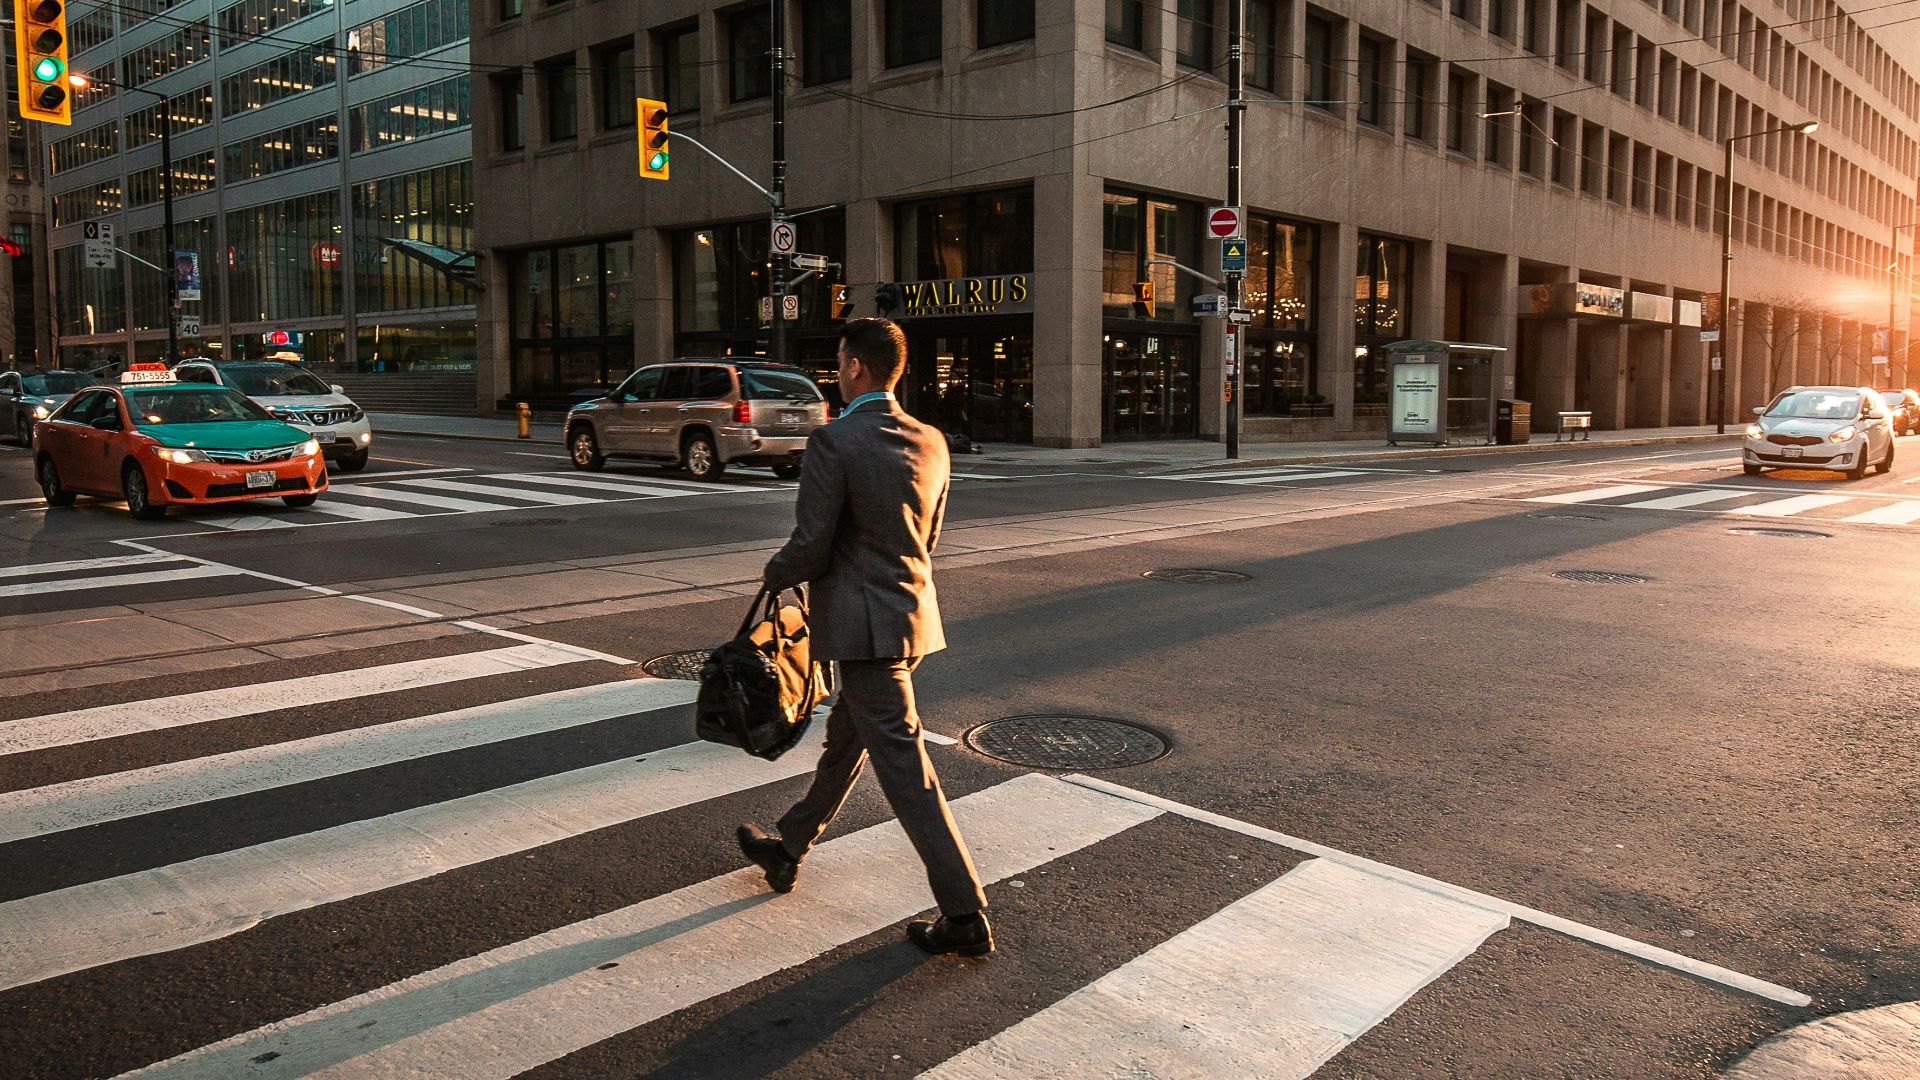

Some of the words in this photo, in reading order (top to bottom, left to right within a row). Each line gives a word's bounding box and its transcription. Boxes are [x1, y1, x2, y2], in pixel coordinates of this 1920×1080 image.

[902, 275, 1028, 308] WALRUS
[183, 324, 200, 336] 40
[131, 371, 170, 381] 751-5555
